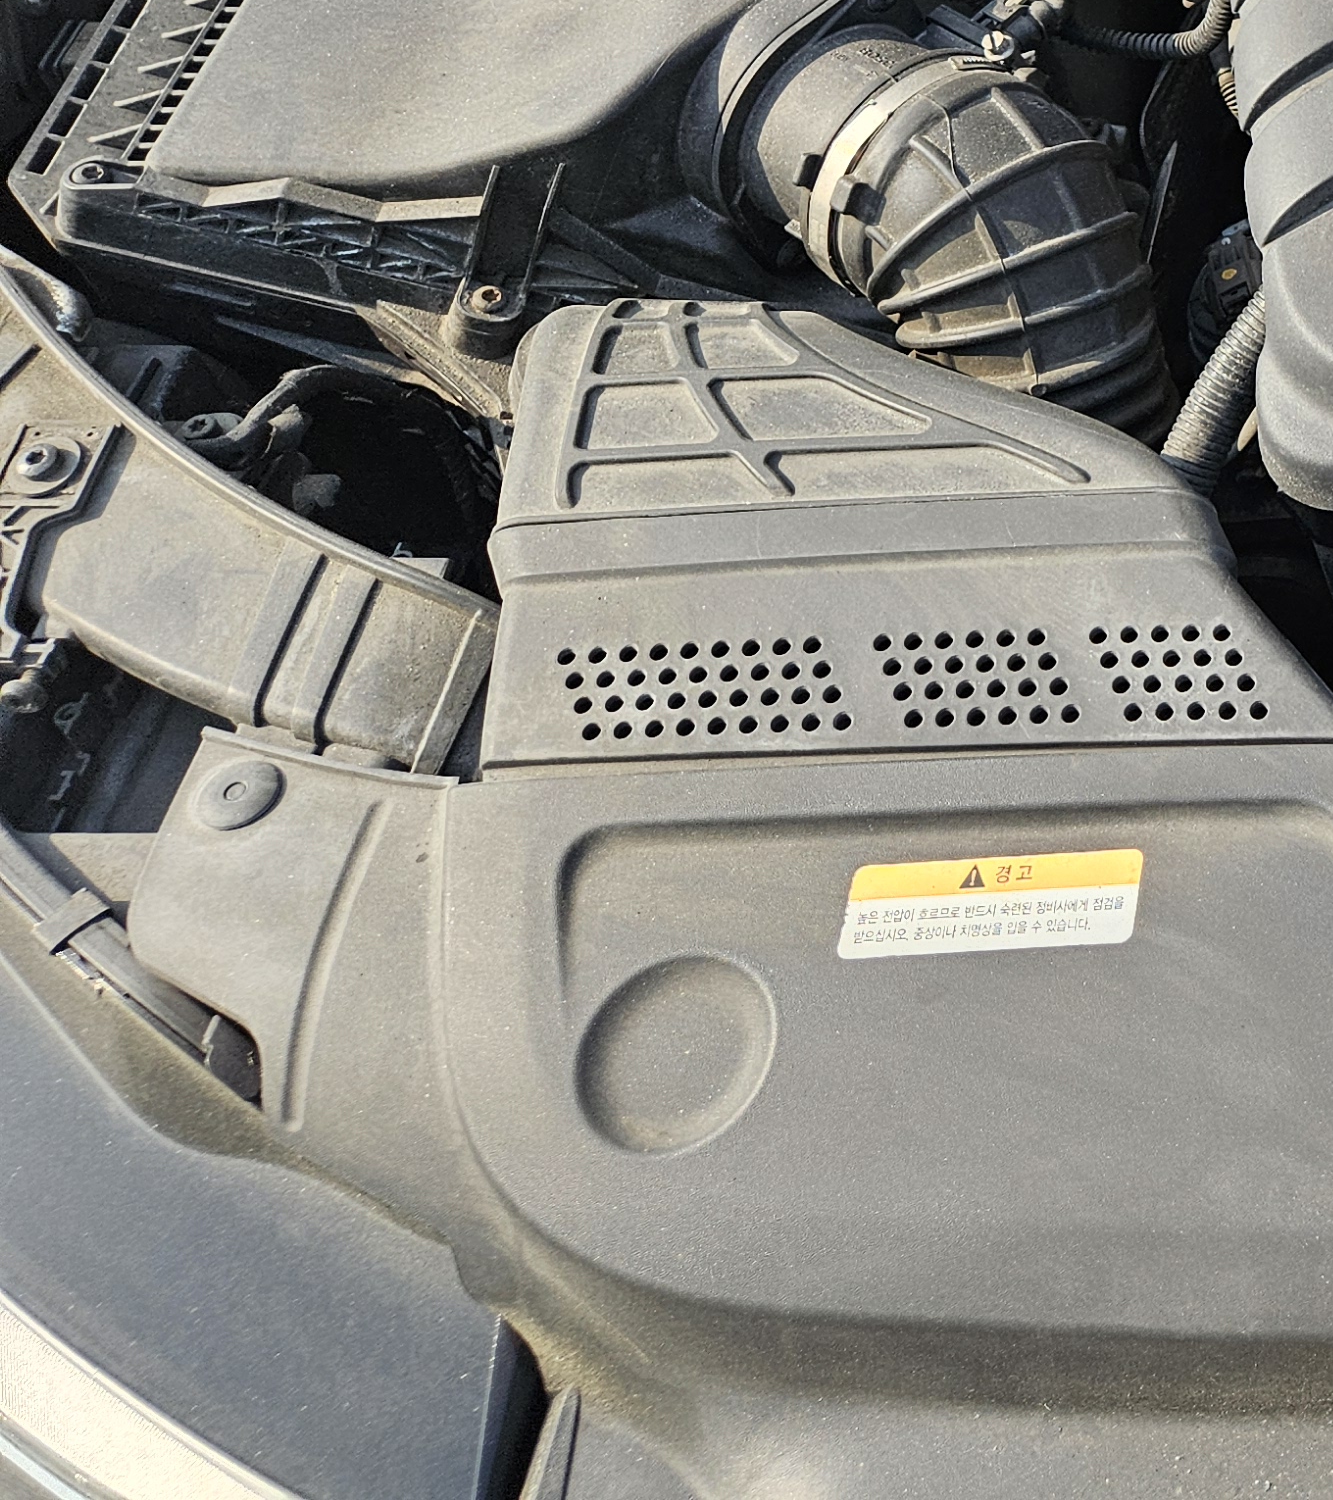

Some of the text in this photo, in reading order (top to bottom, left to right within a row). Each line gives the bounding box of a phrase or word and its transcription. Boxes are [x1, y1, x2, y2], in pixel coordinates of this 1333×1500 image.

[857, 895, 1125, 925] 높은 전압이 흐르므로 반드시 숙련된 정비사에게 점검을
[913, 924, 957, 941] 중상이나
[959, 922, 1003, 938] 치명상을
[1007, 920, 1028, 935] 입을
[1031, 920, 1042, 934] 수
[1046, 917, 1091, 933] 있습니다.
